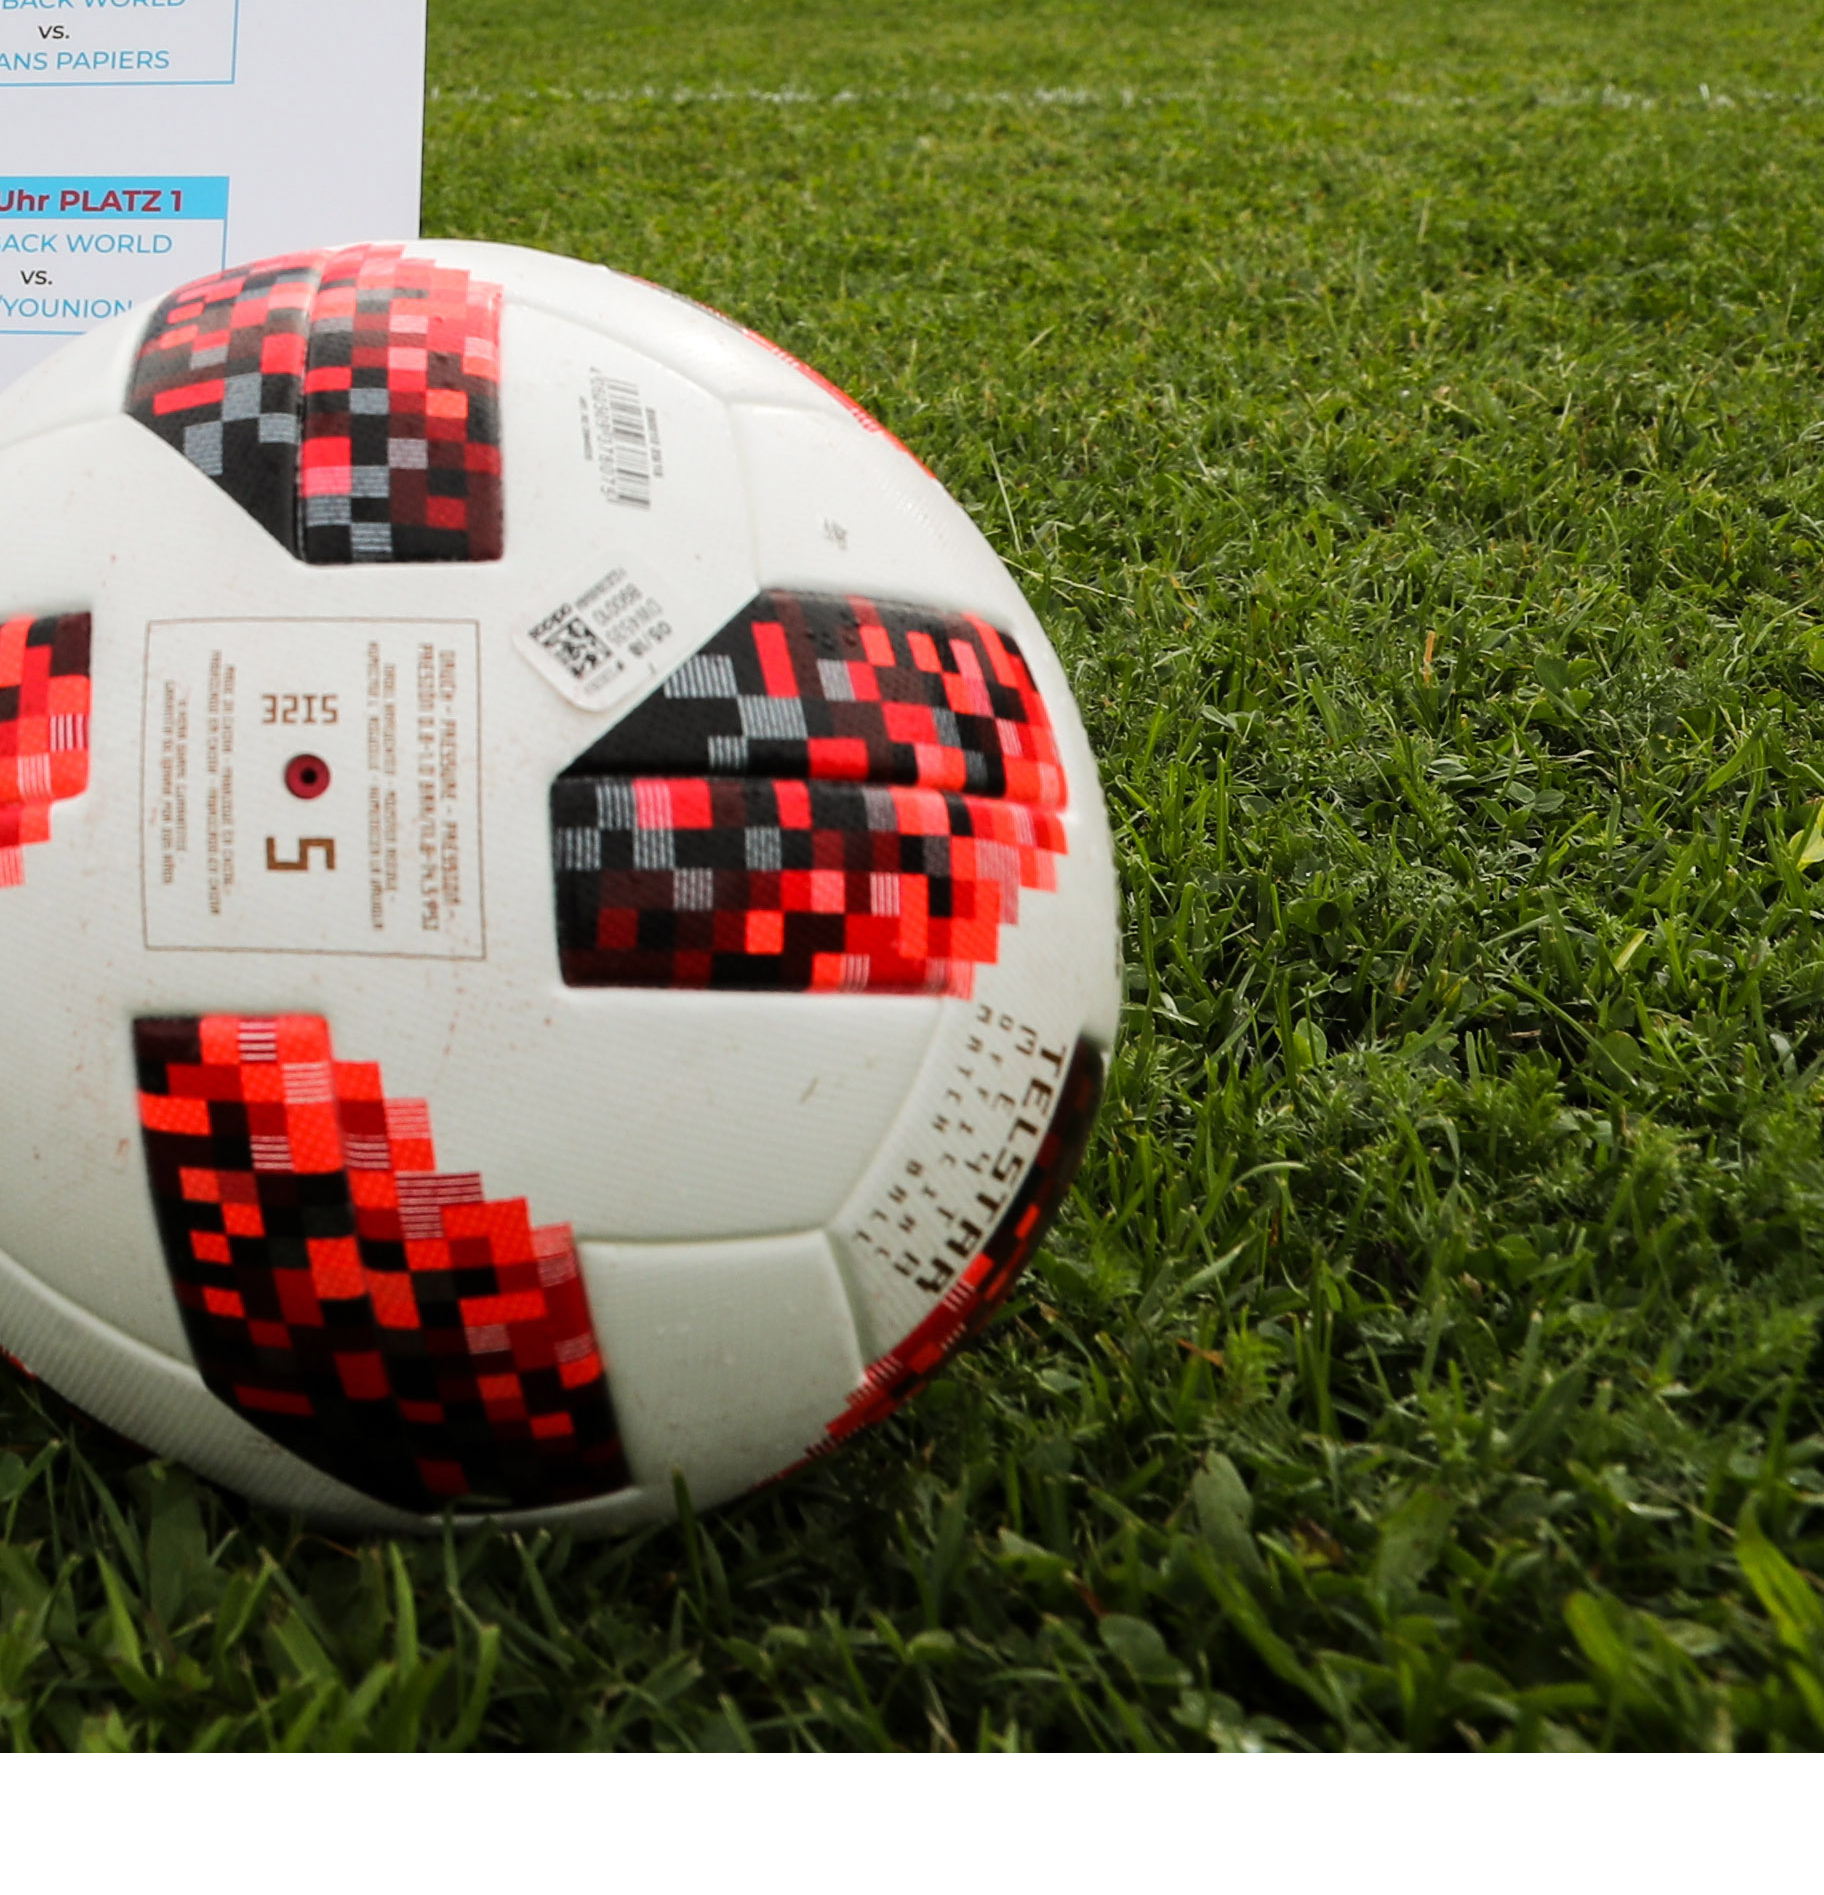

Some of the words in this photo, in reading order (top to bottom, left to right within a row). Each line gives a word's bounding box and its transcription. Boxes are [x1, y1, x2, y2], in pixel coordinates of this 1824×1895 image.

[57, 51, 169, 69] PAPIERS
[60, 190, 161, 211] PLATZ
[171, 191, 181, 211] 1
[66, 234, 172, 253] WORLD
[262, 693, 339, 725] SIZE
[266, 837, 336, 871] 5
[915, 1043, 1068, 1296] TELSTAR
